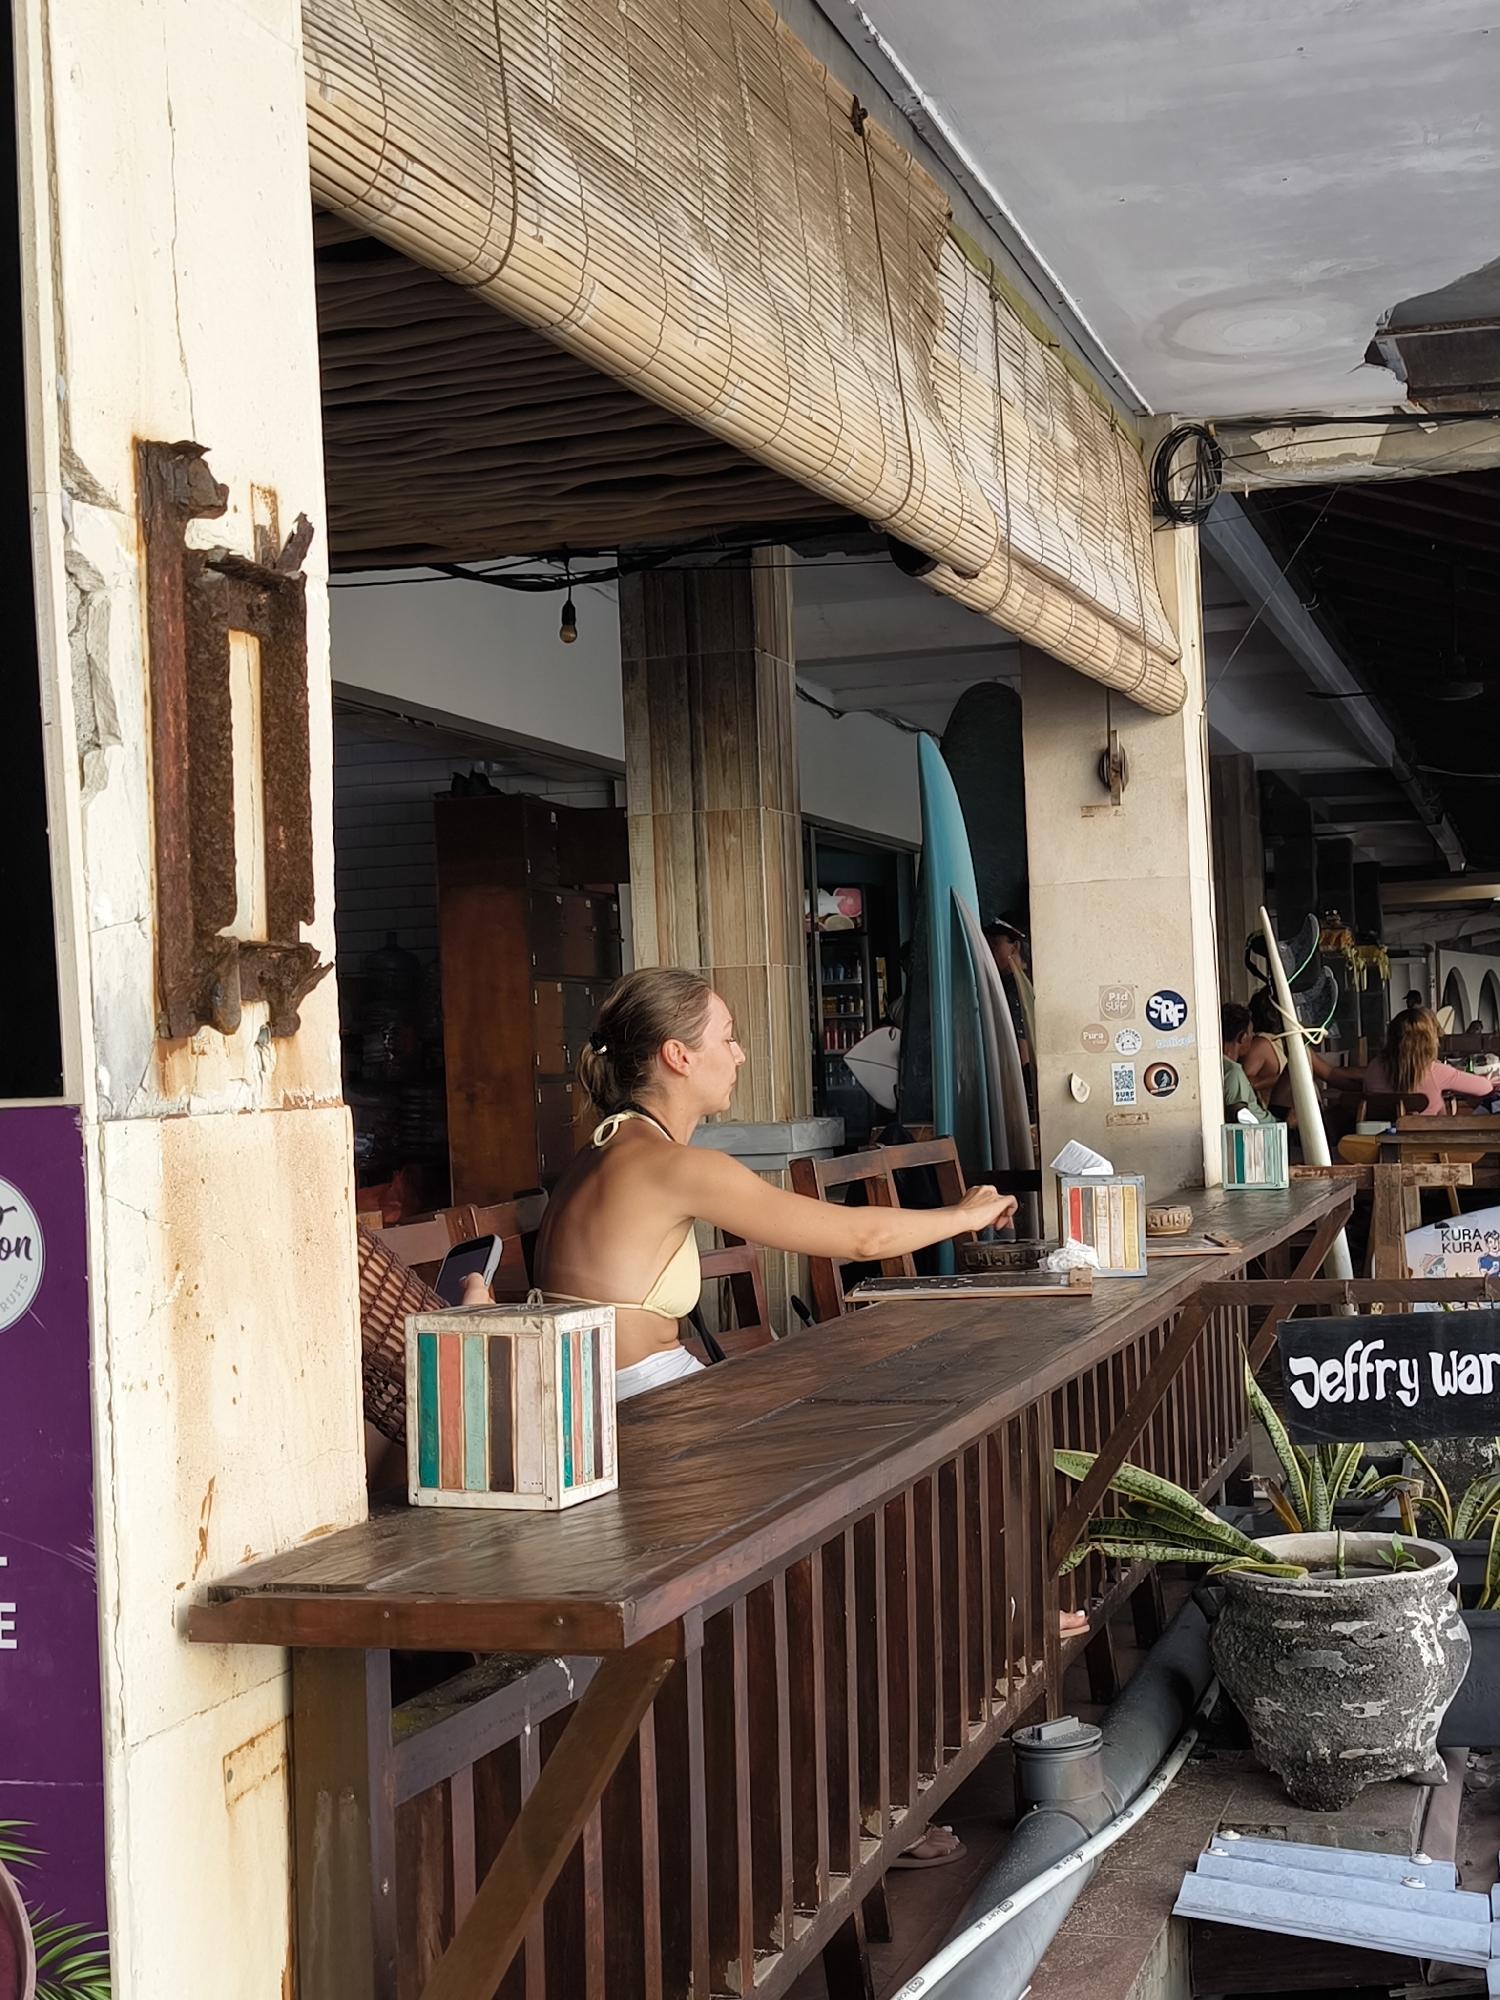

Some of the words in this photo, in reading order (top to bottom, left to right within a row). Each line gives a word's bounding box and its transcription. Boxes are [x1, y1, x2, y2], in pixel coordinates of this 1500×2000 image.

[1149, 995, 1185, 1027] SRF
[1083, 1031, 1104, 1040] Pura
[1441, 1228, 1482, 1241] KURA
[1442, 1241, 1483, 1254] KURA
[1289, 1339, 1419, 1409] Jeffry
[1428, 1350, 1500, 1397] War
